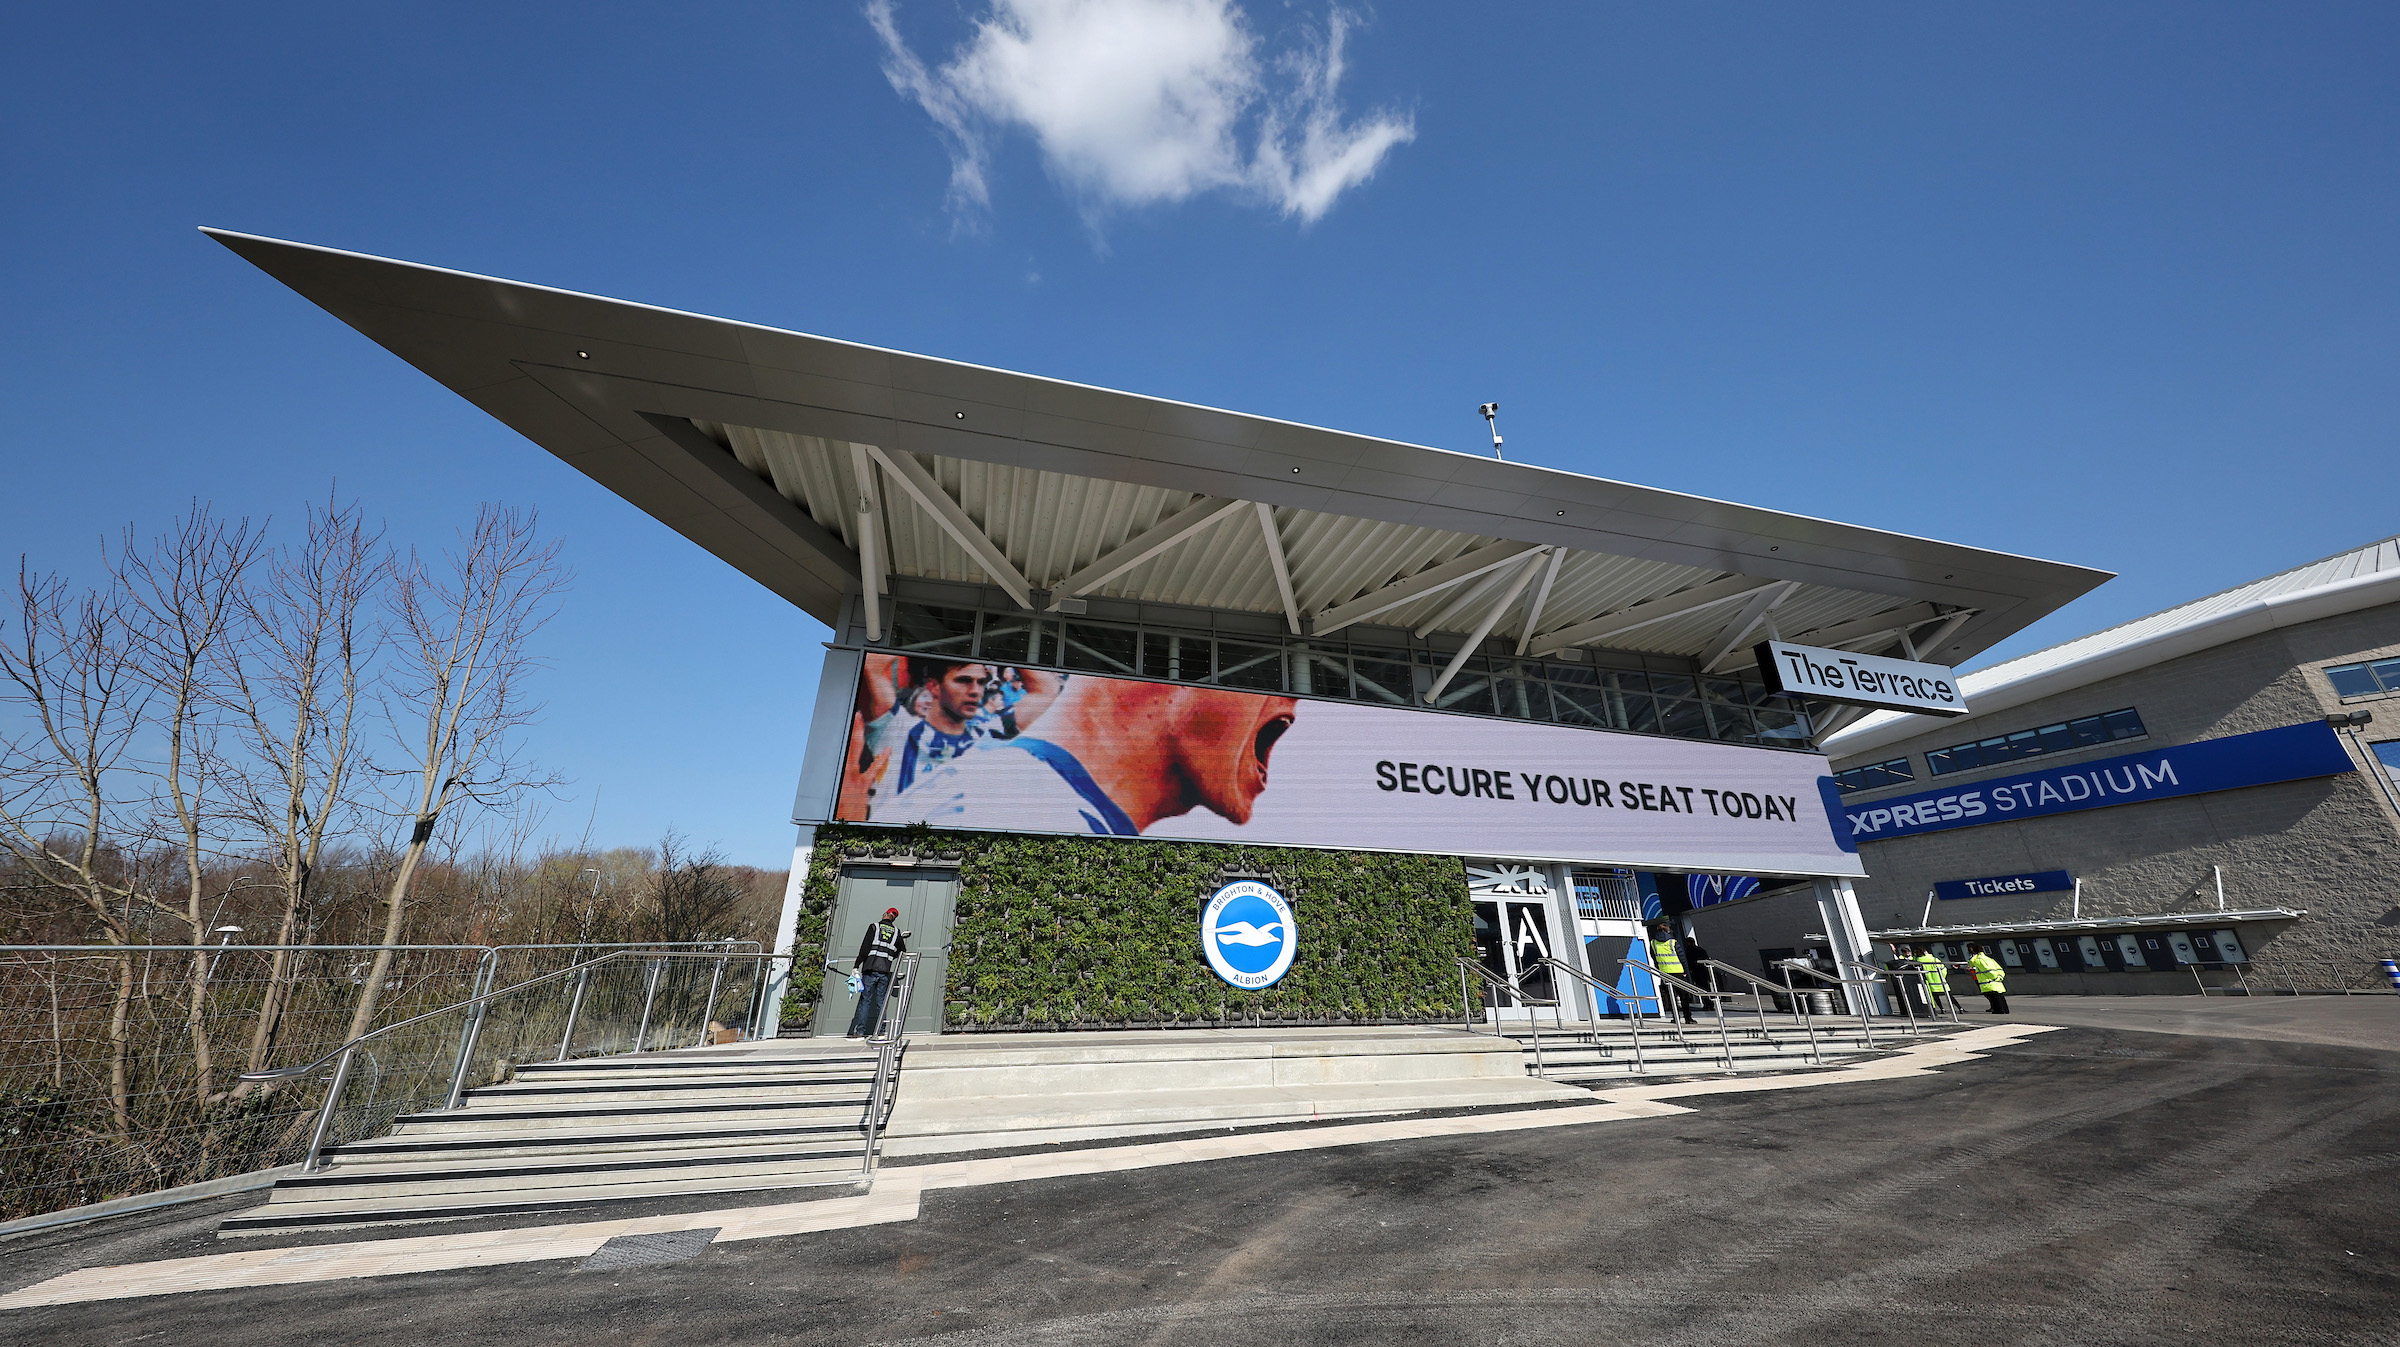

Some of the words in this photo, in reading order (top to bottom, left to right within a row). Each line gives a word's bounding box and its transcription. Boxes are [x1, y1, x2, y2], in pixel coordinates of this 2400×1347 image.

[1781, 651, 1845, 689] The
[1839, 658, 1954, 703] Terrace
[1375, 760, 1514, 801] SECURE
[1521, 772, 1614, 808] YOUR
[1621, 781, 1695, 815] SEAT
[1702, 789, 1797, 822] TODAY
[1991, 758, 2180, 812] STADIUM
[1213, 885, 1254, 911] BRIGHTON
[1257, 887, 1263, 895] &
[1265, 891, 1286, 914] HOVE
[1965, 878, 2036, 895] Tickets
[1233, 974, 1268, 985] ALBION
